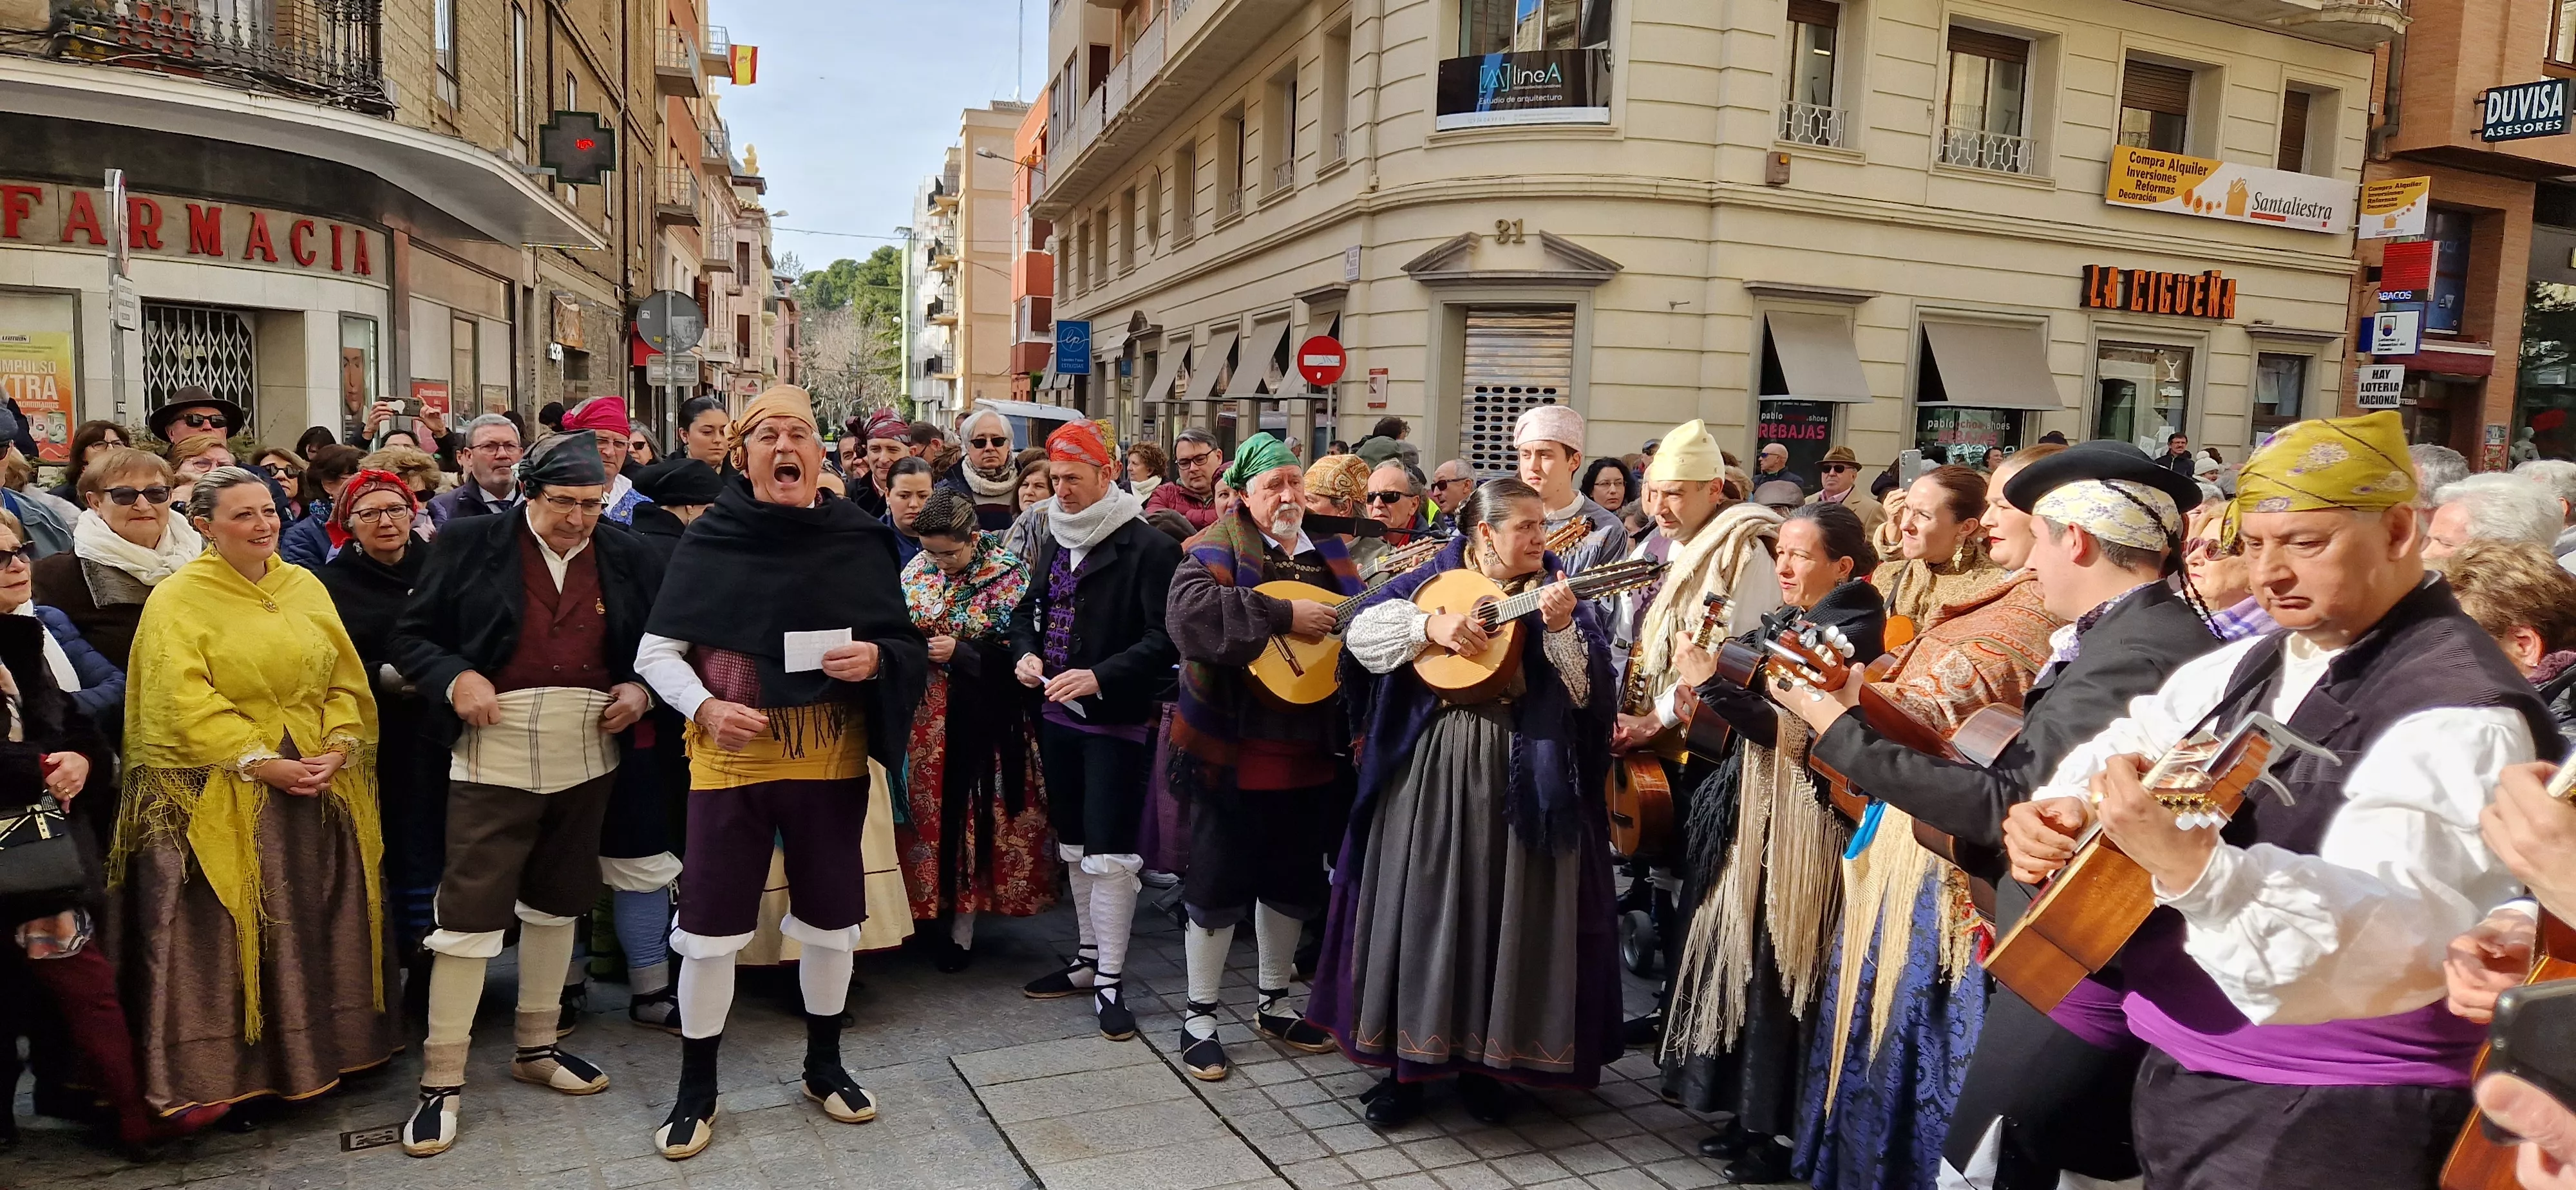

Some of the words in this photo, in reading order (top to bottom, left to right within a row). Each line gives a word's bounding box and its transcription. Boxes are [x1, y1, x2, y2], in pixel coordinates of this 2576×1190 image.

[1478, 96, 1505, 106] Estudio
[1506, 96, 1516, 104] de
[1517, 94, 1563, 104] arquitectura
[2485, 82, 2564, 125] DUVISA
[2484, 119, 2562, 138] ASESORES
[2128, 150, 2165, 169] Compra
[2167, 158, 2209, 177] Alquiler
[2126, 165, 2177, 184] Inversiones
[2135, 179, 2175, 195] Reformas
[2394, 181, 2423, 190] Alquiler
[2117, 188, 2157, 203] Decoración
[2251, 191, 2333, 221] Santaliestra
[0, 184, 372, 275] FARMACIA
[1494, 218, 1526, 245] 31
[2089, 264, 2118, 308] LA
[2130, 269, 2237, 319] CIGÜEÑA
[2371, 369, 2391, 379] HAY
[2360, 382, 2400, 392] LOTERIA
[2358, 395, 2398, 405] NACIONAL
[1758, 422, 1825, 439] REBAJAS
